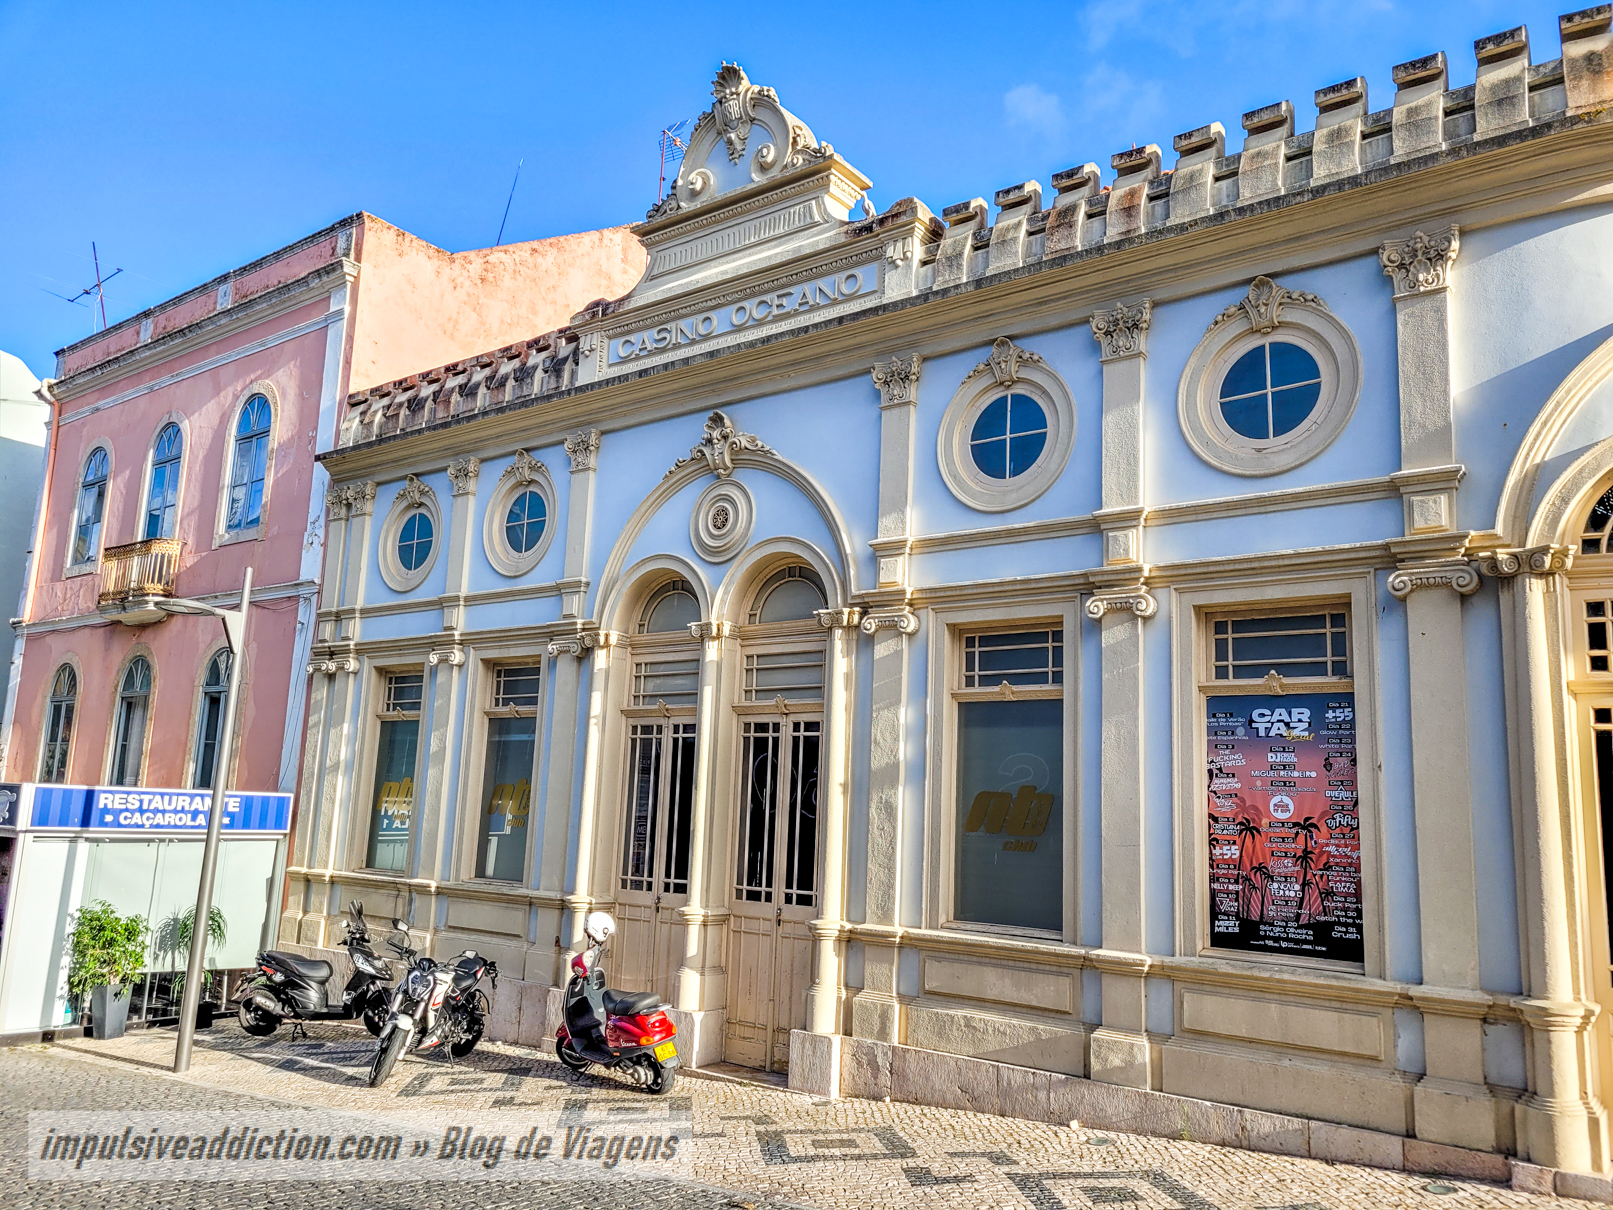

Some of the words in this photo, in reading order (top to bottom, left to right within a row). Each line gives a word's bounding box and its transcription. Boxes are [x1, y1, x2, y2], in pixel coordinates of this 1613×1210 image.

[617, 313, 717, 359] CASINO
[731, 271, 863, 327] OCEANO
[1252, 708, 1311, 723] CAR
[1252, 722, 1309, 737] TAZ
[1208, 753, 1243, 763] FUCKING
[1267, 753, 1280, 763] DJ
[1280, 770, 1318, 778] RENDEIRO
[119, 811, 206, 828] CAÇAROLA
[1266, 930, 1287, 938] Nuno
[1288, 932, 1314, 941] Rocha
[1331, 931, 1361, 940] Crush
